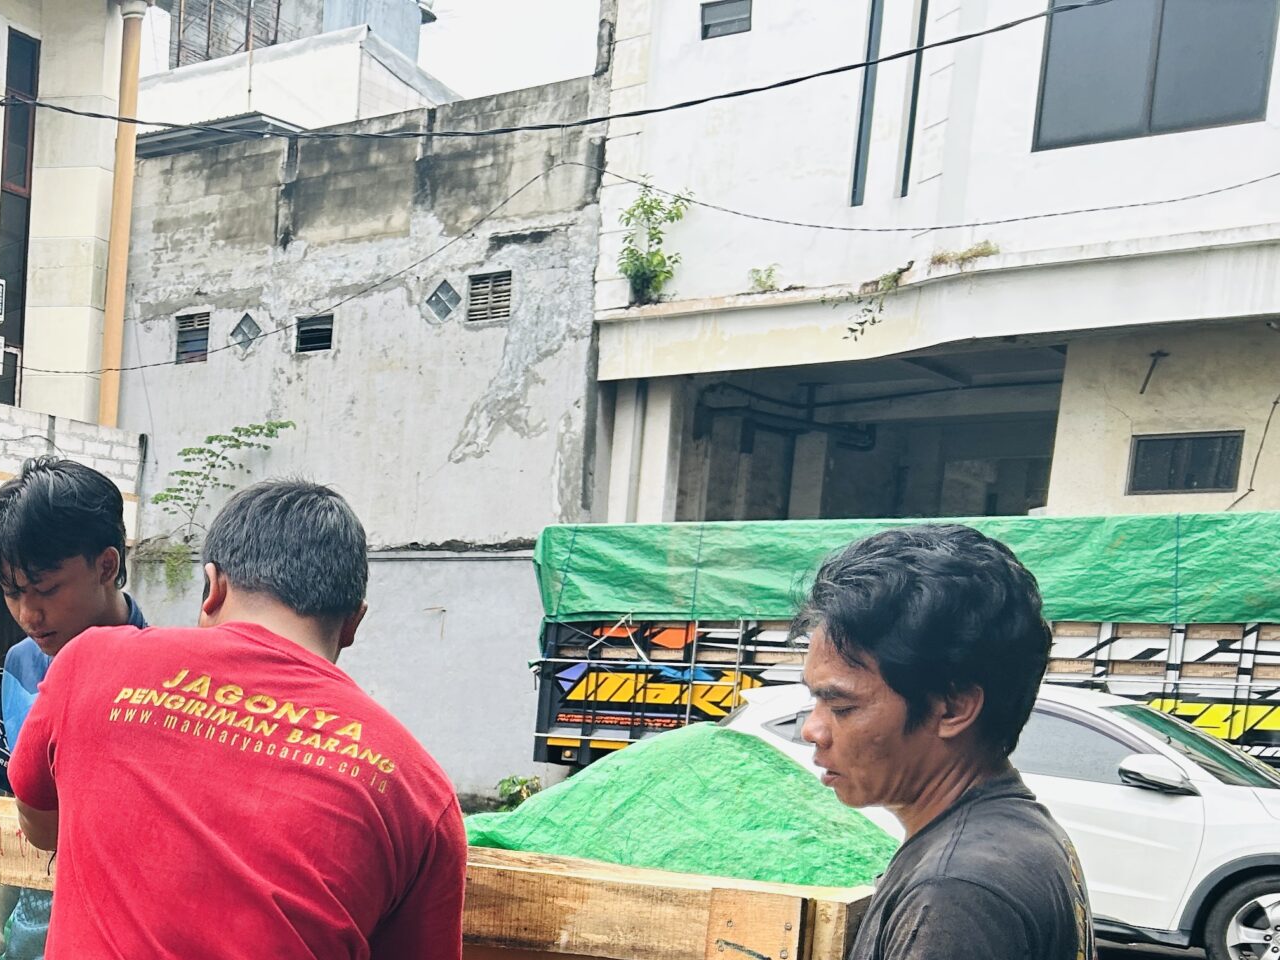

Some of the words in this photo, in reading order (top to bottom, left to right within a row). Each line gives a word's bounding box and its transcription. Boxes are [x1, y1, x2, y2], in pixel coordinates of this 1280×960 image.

[113, 687, 279, 737] PENGIRIMAN
[285, 727, 396, 774] BARANG
[162, 668, 364, 741] JAGONYA
